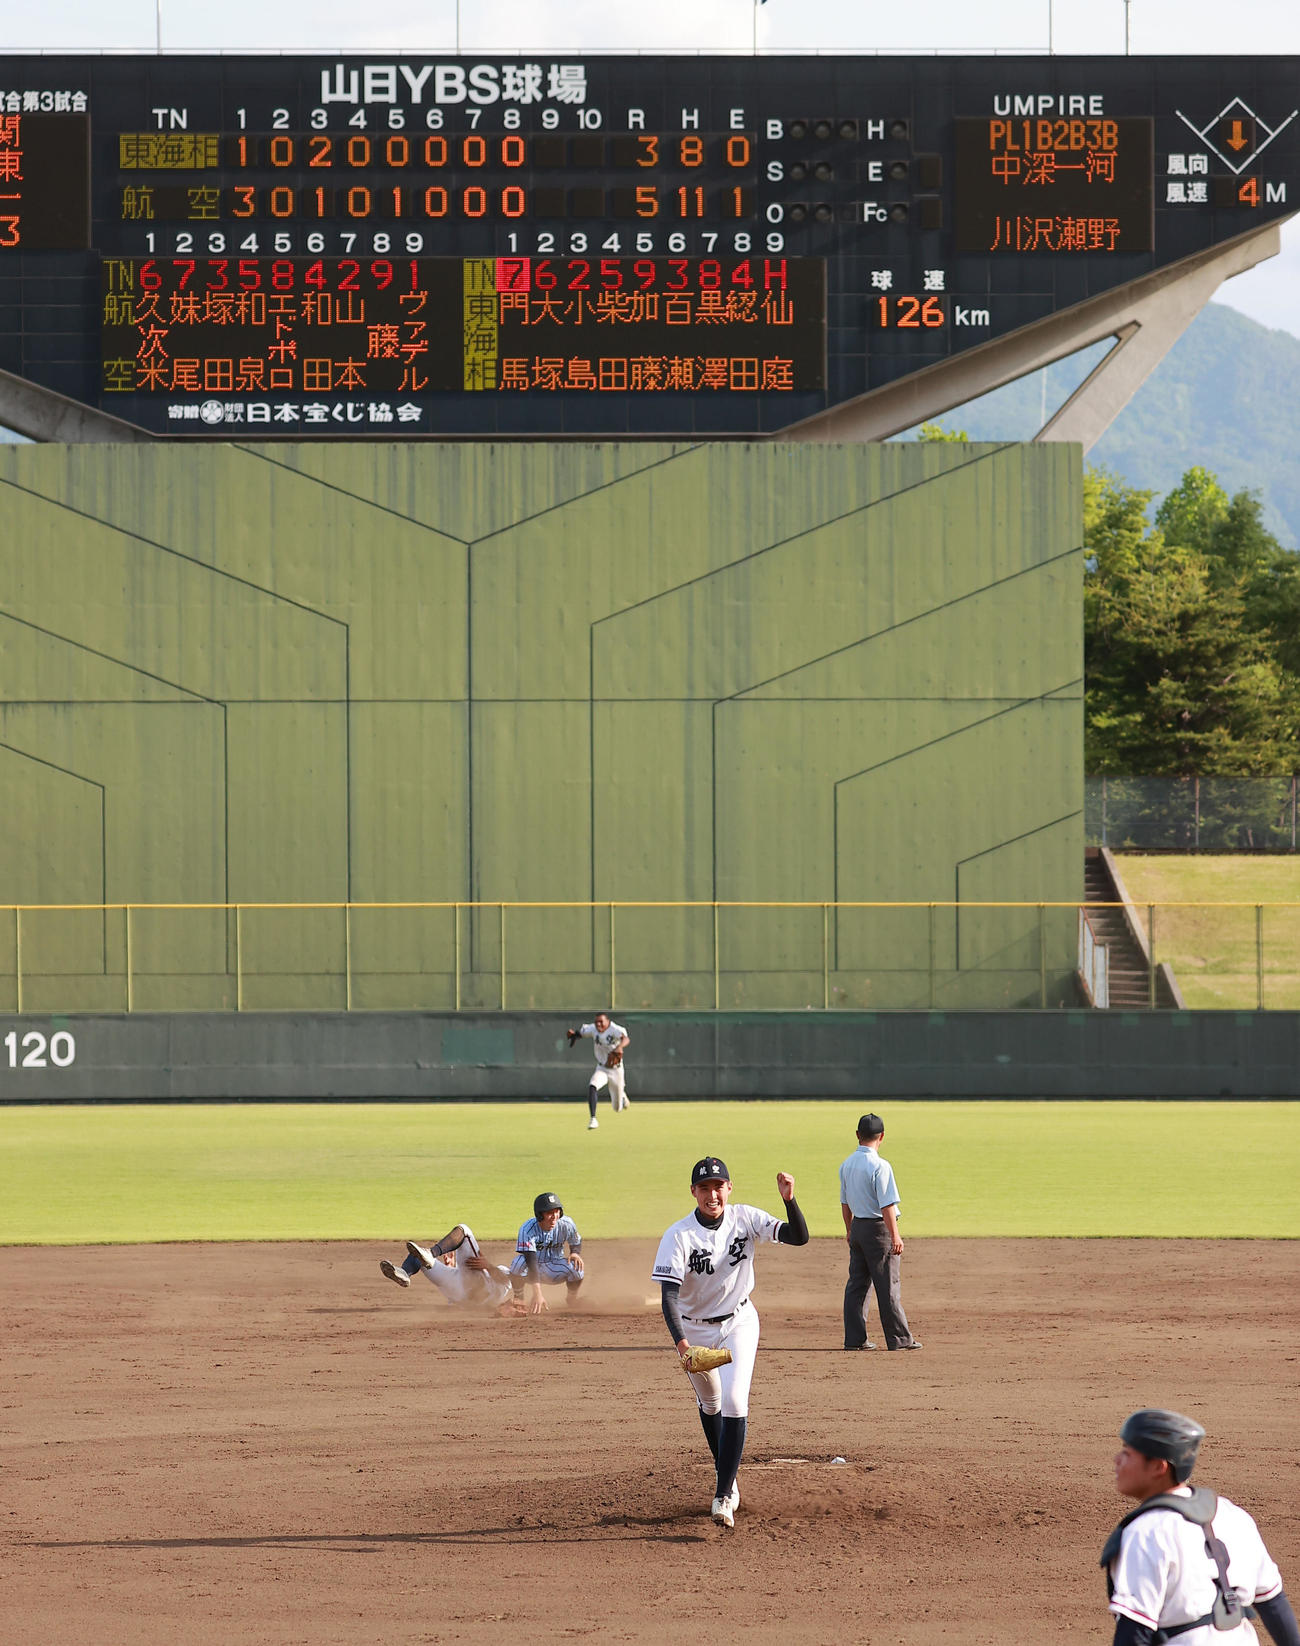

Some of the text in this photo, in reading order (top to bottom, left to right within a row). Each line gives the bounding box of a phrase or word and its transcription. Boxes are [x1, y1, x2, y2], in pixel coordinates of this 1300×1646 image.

[322, 64, 587, 104] 山日YBS球場
[0, 91, 87, 112] 合第3試合
[994, 95, 1103, 115] UMPIRE
[152, 109, 744, 129] TN 1 2 3 4 5 6 7 8 9 10 R H E
[767, 120, 783, 139] B
[868, 120, 883, 139] H
[121, 134, 749, 168] 東海相 1 0 2 0 0 0 0 0 3 8 0
[767, 162, 783, 181] S
[869, 162, 882, 181] E
[1167, 154, 1208, 174] 風向
[233, 187, 254, 216] 3
[272, 188, 292, 216] 0
[316, 187, 323, 216] 1
[349, 187, 370, 216] 0
[393, 187, 400, 216] 1
[426, 187, 447, 216] 0
[464, 187, 486, 217] 0
[502, 186, 524, 217] 0
[636, 187, 658, 216] 5
[679, 187, 703, 216] 11
[734, 187, 741, 216] 1
[1166, 178, 1285, 206] 風速 4 M
[767, 204, 783, 223] O
[146, 233, 423, 252] 1 2 3 4 5 6 7 8 9
[508, 233, 783, 252] 1 2 3 4 5 6 7 8 9
[104, 260, 417, 290] TN 6 7 3 5 8 4 2 9 1
[465, 260, 786, 291] TN 7 6 2 5 9 3 8 4 H
[879, 296, 989, 327] 126 km
[247, 403, 422, 422] 日本宝くじ協会
[4, 1031, 76, 1068] 120
